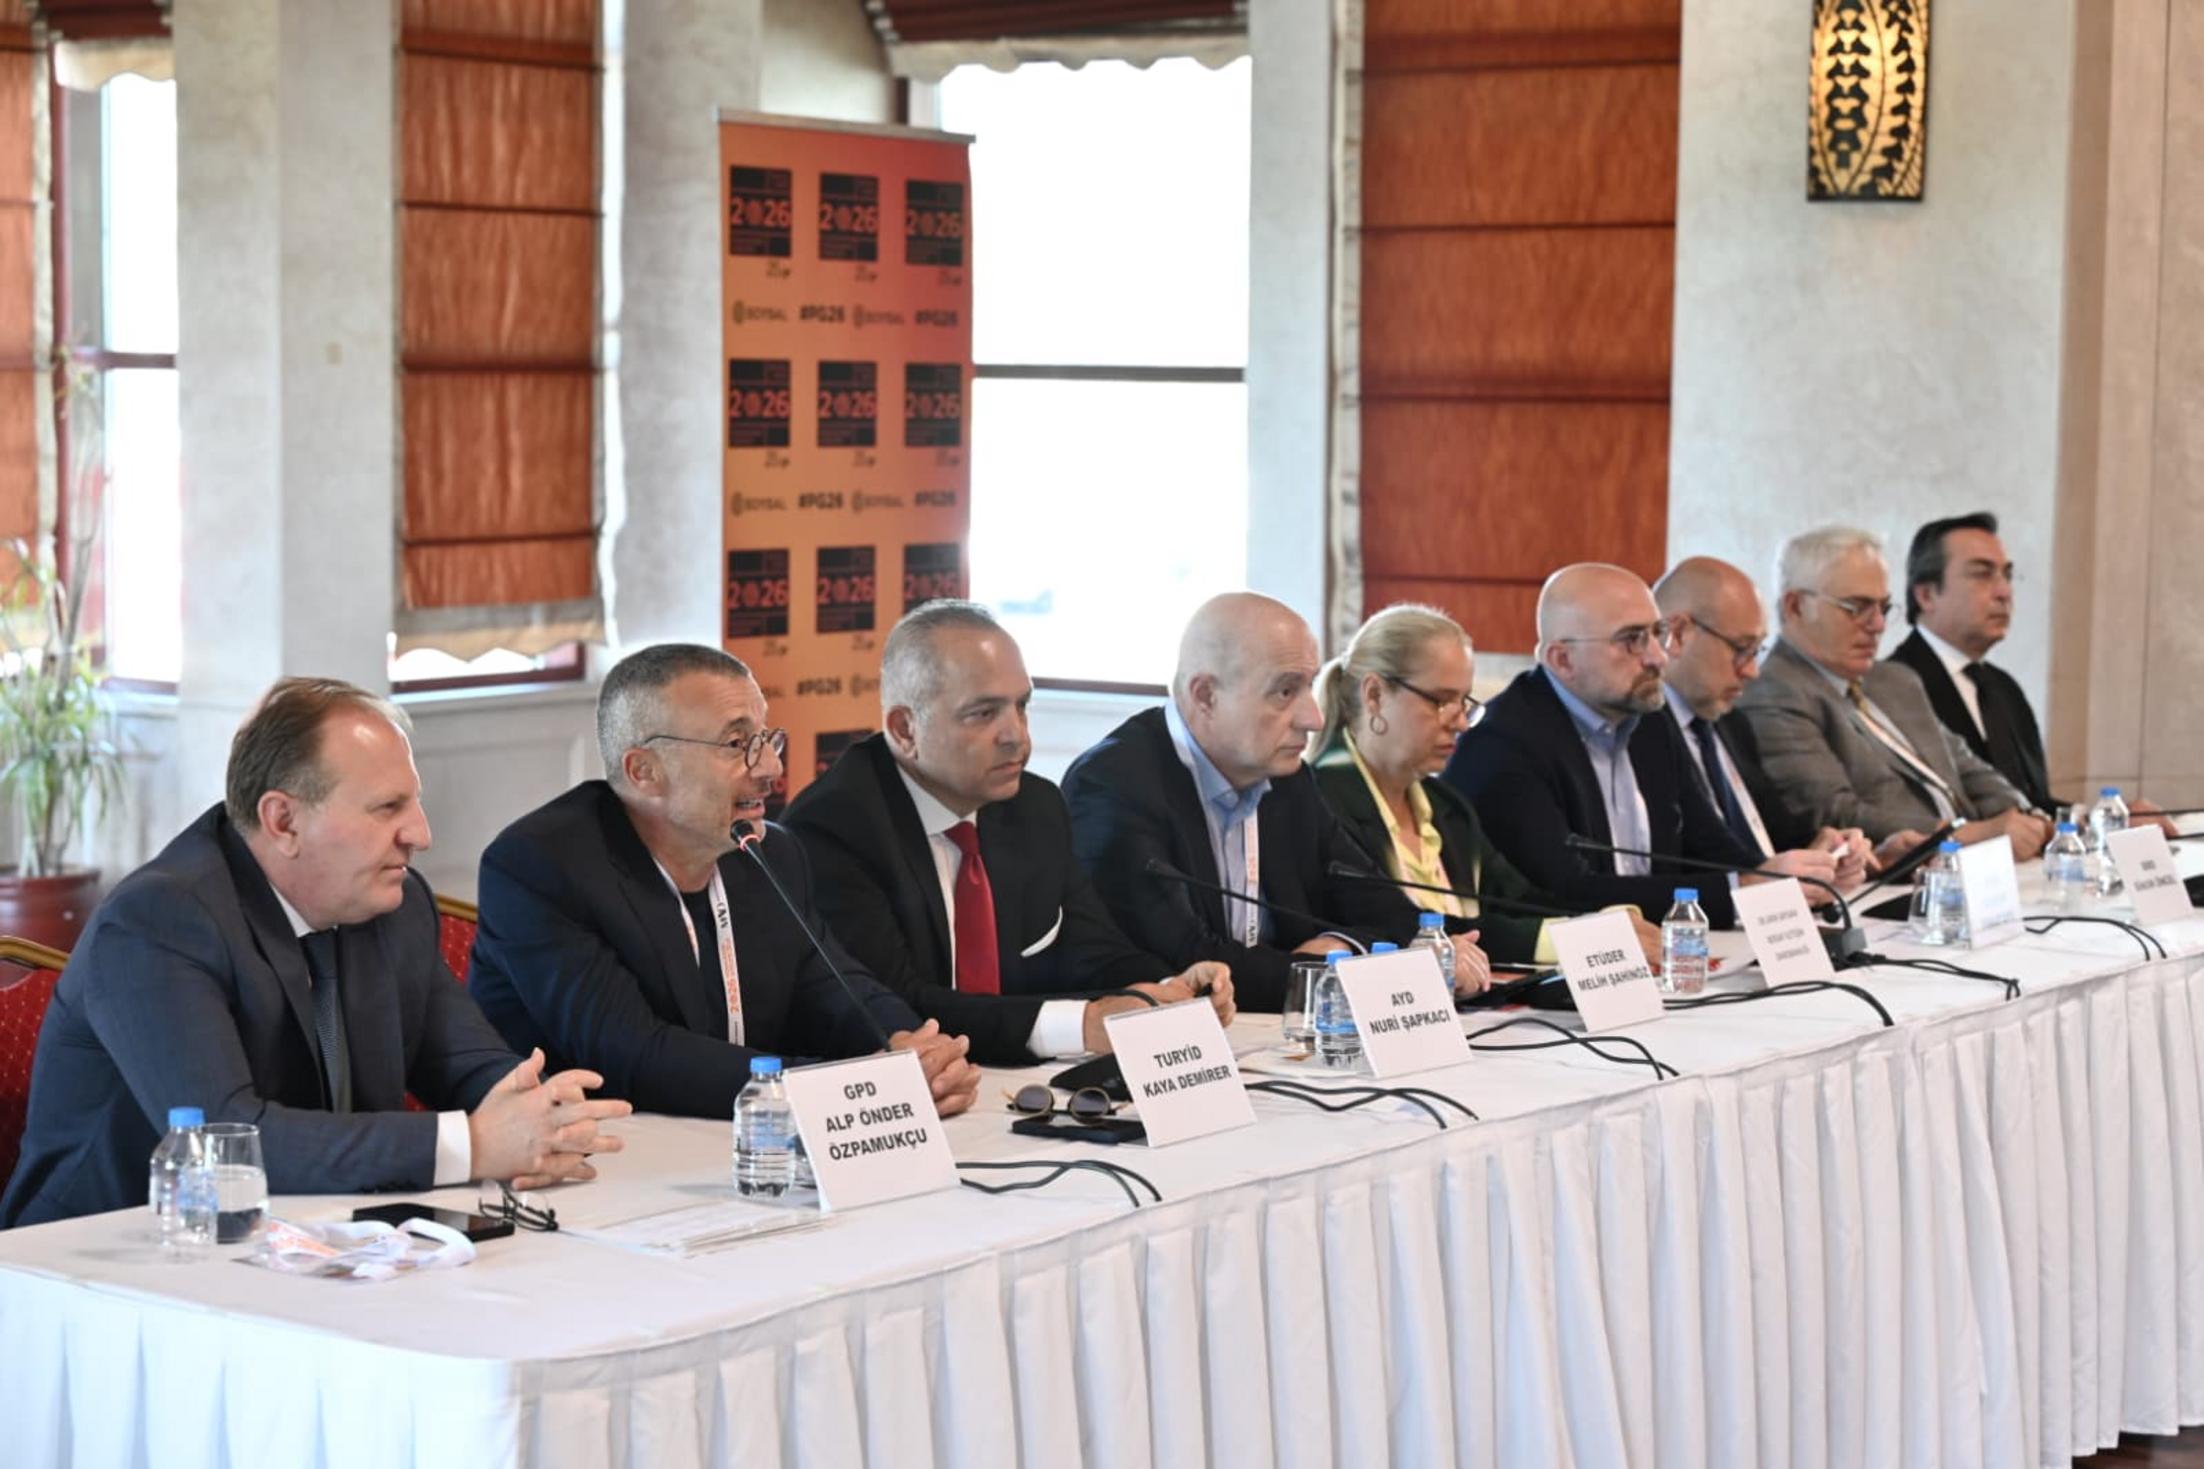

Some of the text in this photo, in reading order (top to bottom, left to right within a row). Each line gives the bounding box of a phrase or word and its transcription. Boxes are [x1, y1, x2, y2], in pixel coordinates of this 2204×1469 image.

[1391, 991, 1414, 1007] AYD
[1369, 1009, 1451, 1034] NURİ ŞAPKACI
[1154, 1044, 1202, 1068] TURYİD
[843, 1081, 877, 1100] GPD
[1143, 1065, 1231, 1098] KAYA DEMİRER
[826, 1103, 914, 1132] ALP ÖNDER
[829, 1128, 927, 1160] ÖZPAMUKÇU
